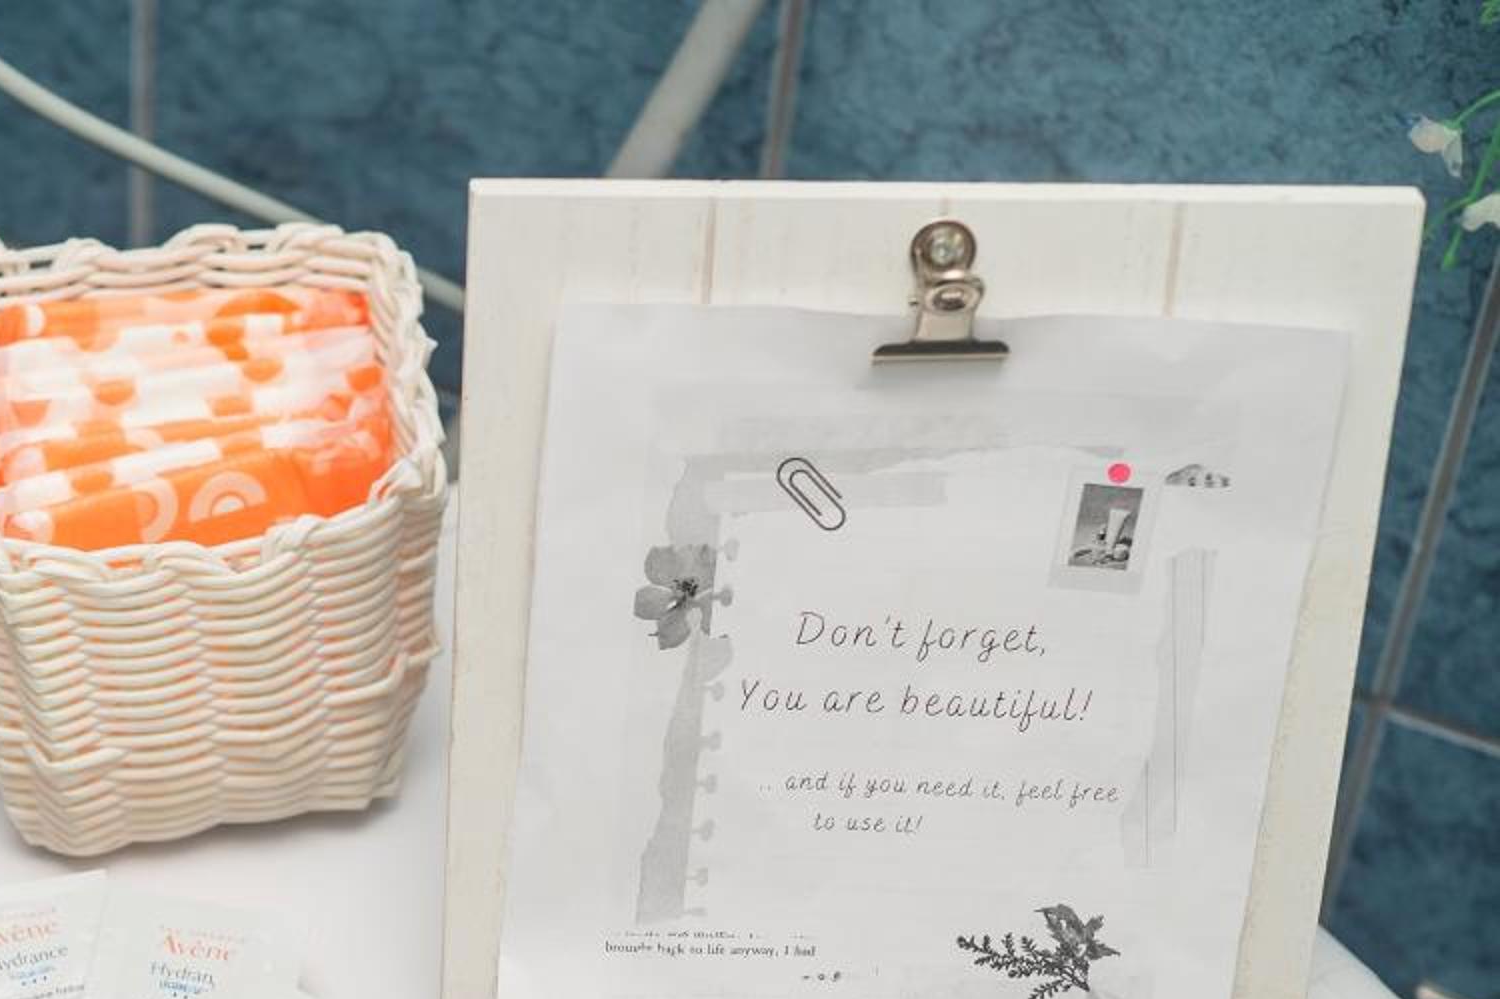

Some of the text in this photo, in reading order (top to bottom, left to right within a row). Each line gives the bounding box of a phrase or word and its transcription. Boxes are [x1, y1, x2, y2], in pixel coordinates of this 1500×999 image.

[796, 610, 1046, 662] Don't forget,
[740, 678, 1092, 732] You are beautiful!
[785, 771, 828, 792] and
[839, 773, 858, 797] if
[866, 778, 906, 797] you
[916, 776, 973, 798] need
[1016, 779, 1062, 804] feel
[1070, 785, 1119, 806] free
[813, 813, 924, 833] to use it!
